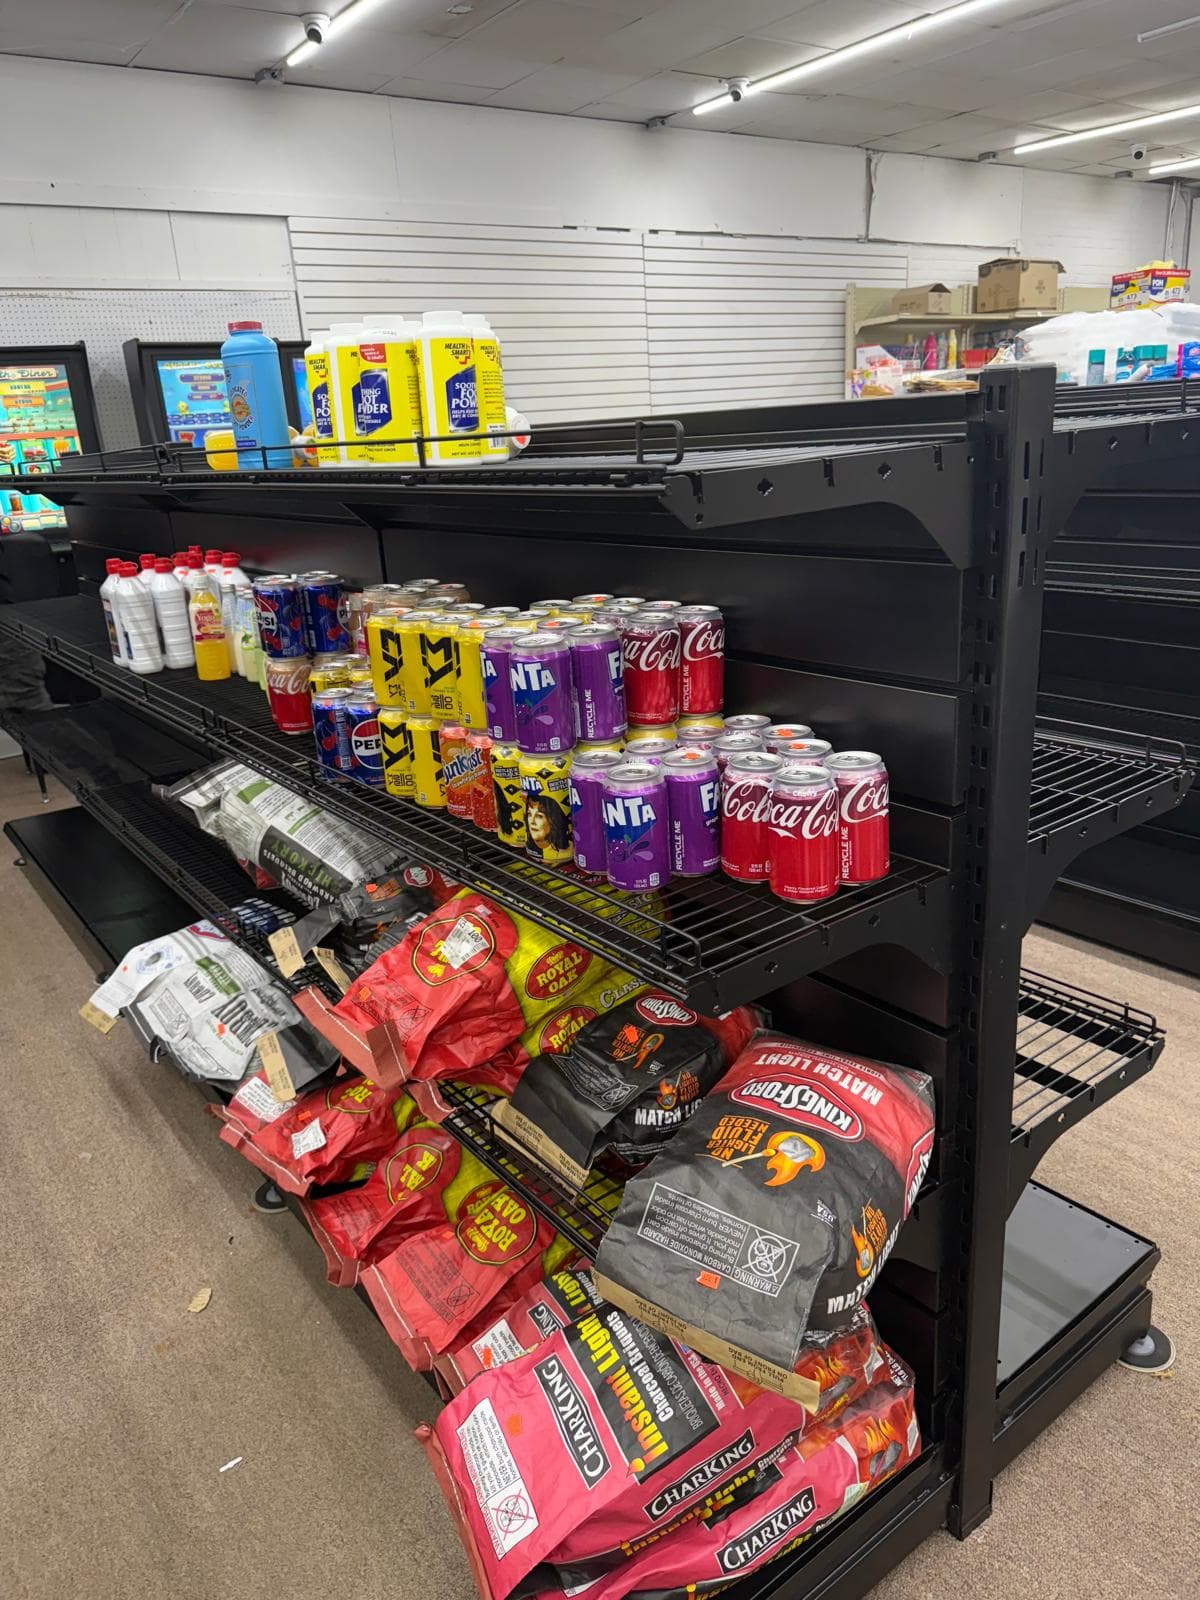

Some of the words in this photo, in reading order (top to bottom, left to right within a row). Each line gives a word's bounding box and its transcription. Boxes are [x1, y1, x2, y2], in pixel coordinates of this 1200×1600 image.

[585, 689, 591, 701] ME
[585, 701, 596, 738] RECYCLE
[674, 821, 681, 834] ME
[841, 827, 849, 841] ME
[674, 835, 683, 871] RECYCLE
[842, 841, 850, 878] RECYCLE
[269, 838, 333, 887] HICKORY
[535, 950, 583, 987] ROYAL
[547, 967, 579, 993] OAK
[640, 998, 691, 1019] KINGSFORD
[548, 1015, 589, 1048] ROYAL
[752, 1052, 811, 1070] LIGHT
[813, 1060, 883, 1105] MATCH
[635, 1106, 680, 1125] MATCH
[740, 1082, 852, 1131] KINGSFORD
[718, 1116, 768, 1132] NEEDED
[711, 1125, 762, 1144] FLUID
[705, 1139, 755, 1154] LIGHTER
[710, 1145, 733, 1159] NO
[654, 1194, 674, 1207] inside
[674, 1203, 701, 1219] charcoal
[675, 1215, 687, 1224] has
[692, 1202, 719, 1219] vehicles
[646, 1218, 660, 1227] can
[655, 1214, 678, 1228] carbon
[677, 1224, 688, 1233] off
[686, 1220, 705, 1232] which
[701, 1215, 717, 1227] burn
[642, 1226, 669, 1245] HAZARD
[659, 1224, 679, 1237] inside
[688, 1229, 706, 1240] gives
[718, 1222, 744, 1239] NEVER
[669, 1239, 703, 1260] MONOXIDE
[679, 1233, 707, 1251] charcoal
[707, 1245, 734, 1263] Burning
[726, 1247, 737, 1256] kill
[702, 1254, 731, 1273] CARBON
[551, 1269, 586, 1306] Light
[732, 1268, 772, 1291] WARNING
[574, 1312, 620, 1373] Light
[604, 1309, 643, 1364] Briquets
[650, 1349, 663, 1361] DE
[693, 1365, 707, 1379] the
[707, 1365, 718, 1376] EN
[631, 1360, 674, 1422] Charcoal
[668, 1380, 683, 1393] DE
[700, 1376, 713, 1388] in
[711, 1374, 729, 1396] HECHO
[706, 1385, 725, 1410] Made
[538, 1357, 605, 1474] CHARKING
[673, 1389, 704, 1430] BRIQUETAS
[485, 1425, 499, 1451] charcoal
[495, 1451, 503, 1464] burn
[498, 1464, 511, 1484] NEVER
[651, 1438, 753, 1516] CHARKING
[723, 1495, 814, 1569] CHARKING
